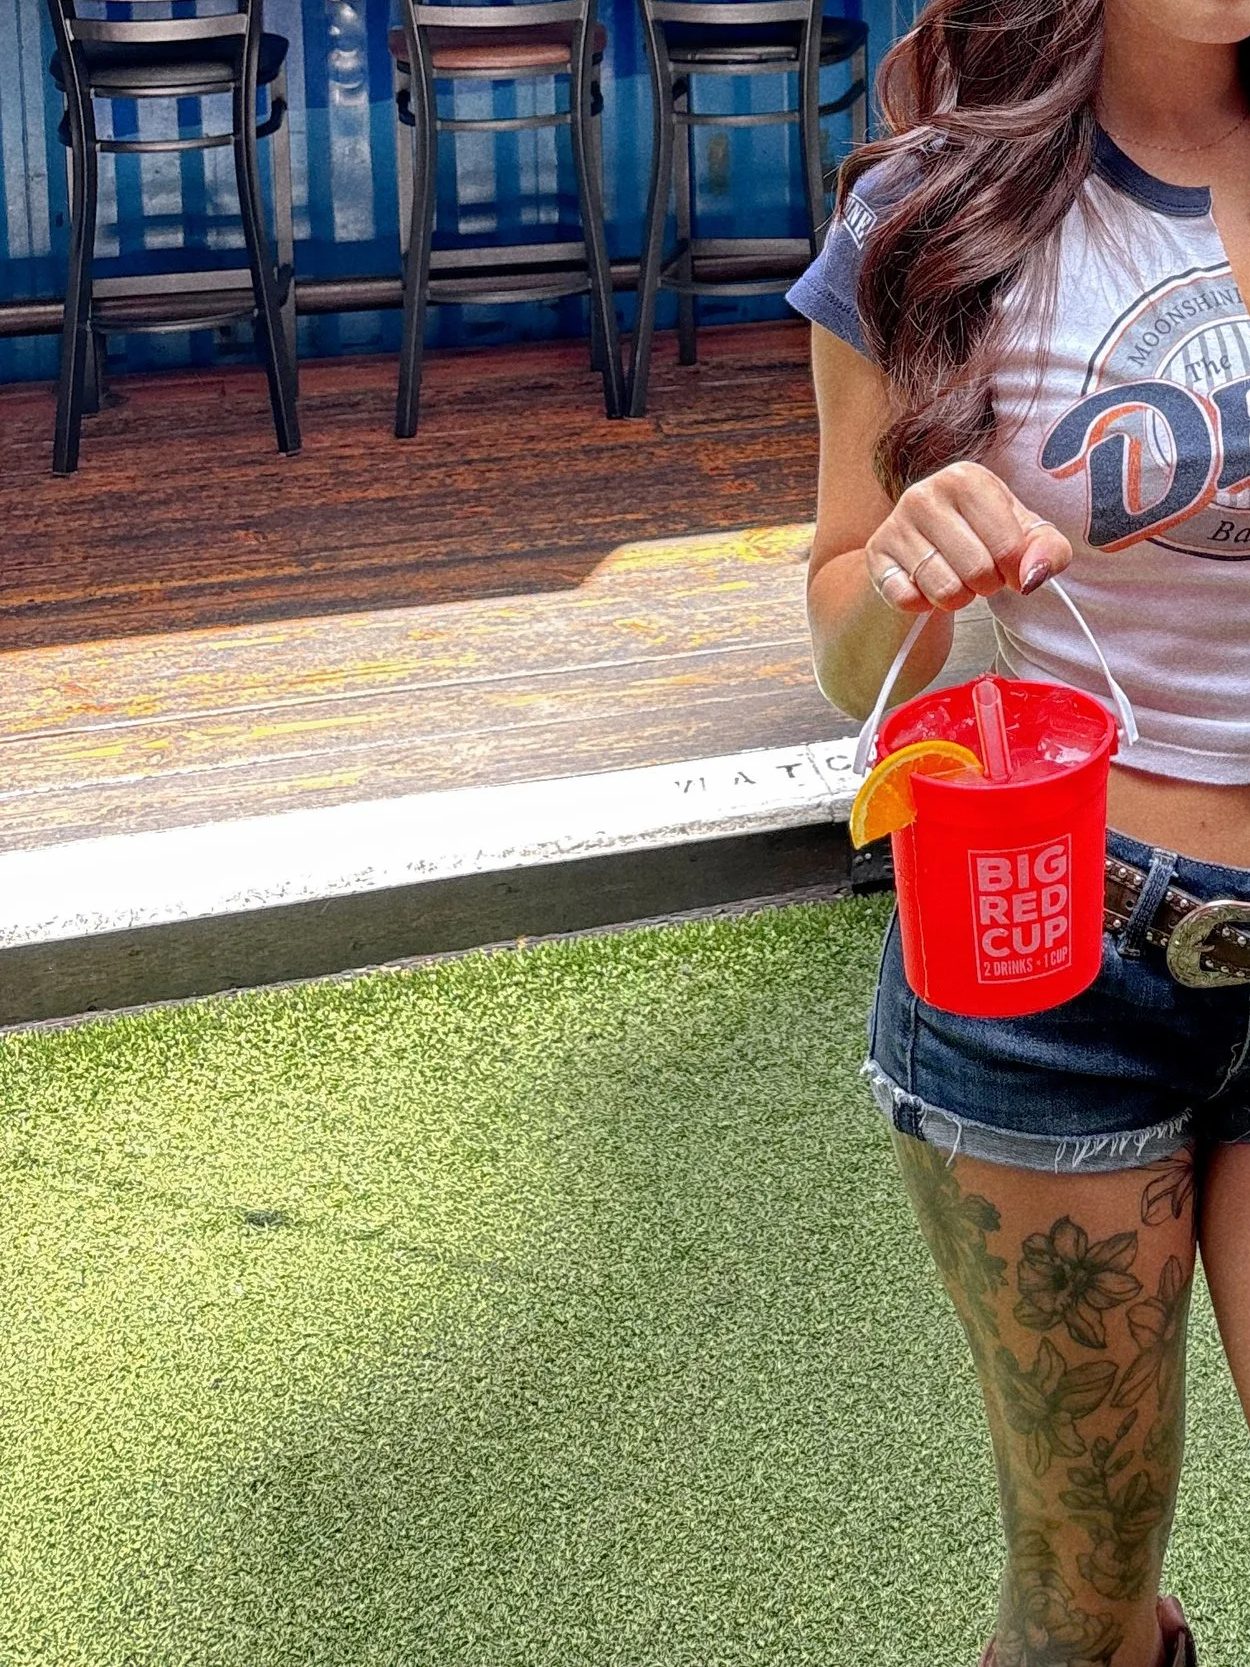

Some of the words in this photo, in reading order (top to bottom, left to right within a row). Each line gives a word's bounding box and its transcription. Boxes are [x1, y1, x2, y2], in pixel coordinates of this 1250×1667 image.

[1184, 353, 1233, 383] The
[674, 754, 853, 794] WATC
[975, 844, 1068, 893] BIG
[978, 883, 1069, 926] RED
[981, 915, 1069, 958] CUP
[983, 961, 991, 977] 2
[993, 957, 1034, 977] DRINKS
[1043, 952, 1049, 968] 1
[1050, 946, 1068, 966] CUP
